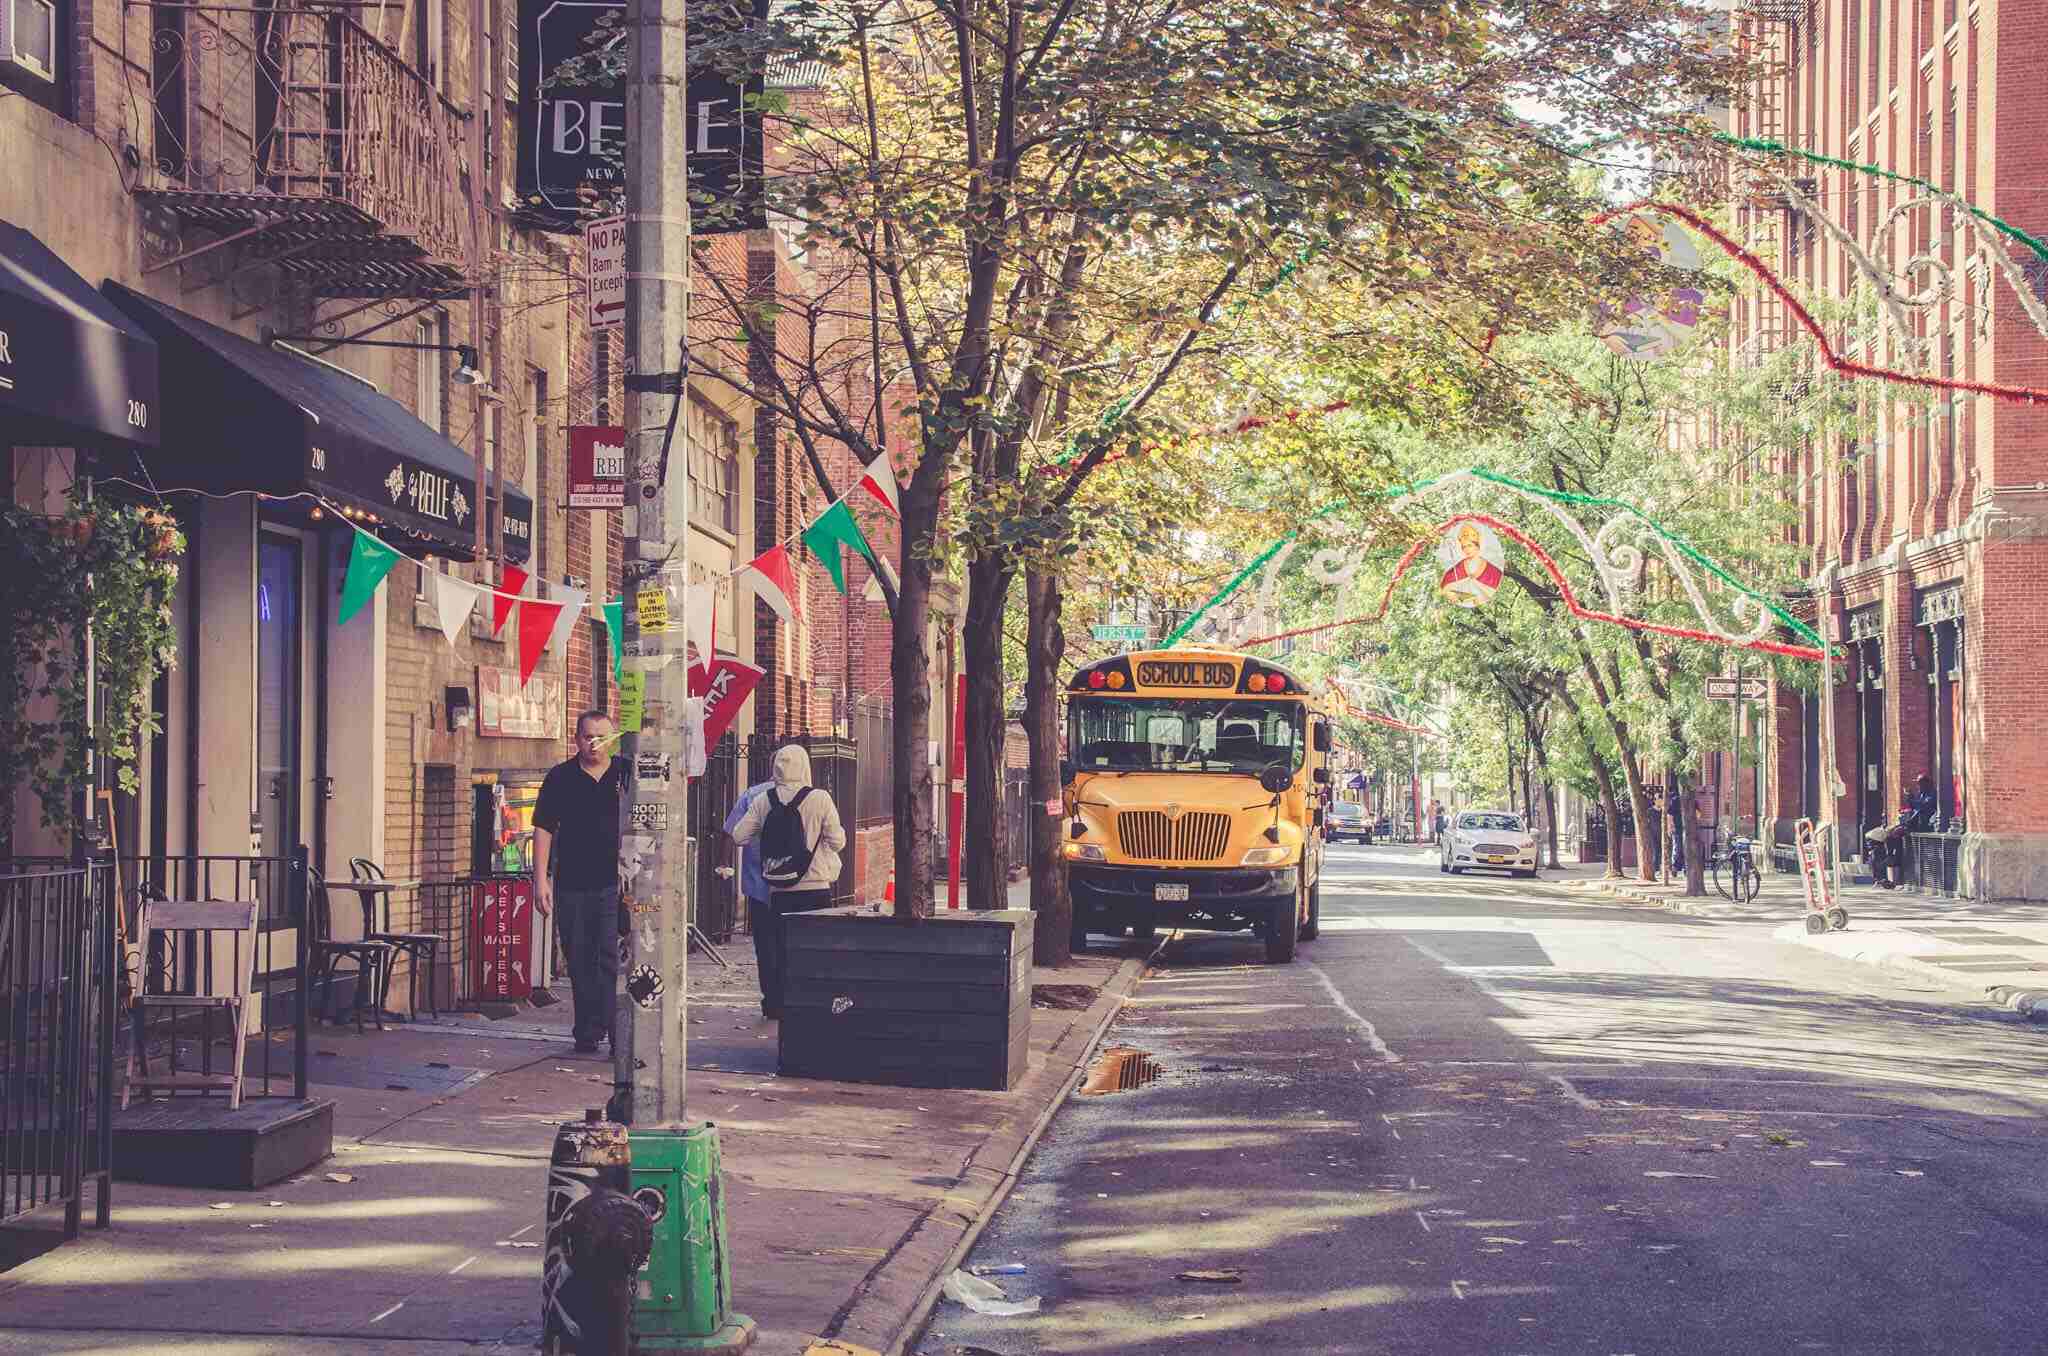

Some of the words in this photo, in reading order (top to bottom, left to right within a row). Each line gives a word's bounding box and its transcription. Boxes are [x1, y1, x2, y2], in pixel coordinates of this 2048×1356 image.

[552, 98, 729, 155] BEE
[585, 167, 616, 180] NEW
[592, 231, 608, 250] NO
[593, 258, 612, 272] 8am
[128, 399, 147, 428] 280
[311, 447, 326, 471] 280
[418, 470, 450, 520] BELLE
[1142, 663, 1200, 685] SCHOOL
[1204, 664, 1233, 686] BUS
[1711, 682, 1732, 694] ONE
[632, 804, 667, 813] ROOM
[632, 813, 667, 822] ZOOM
[497, 884, 508, 932] KEYS
[483, 934, 522, 945] MADE
[497, 947, 508, 995] HERE
